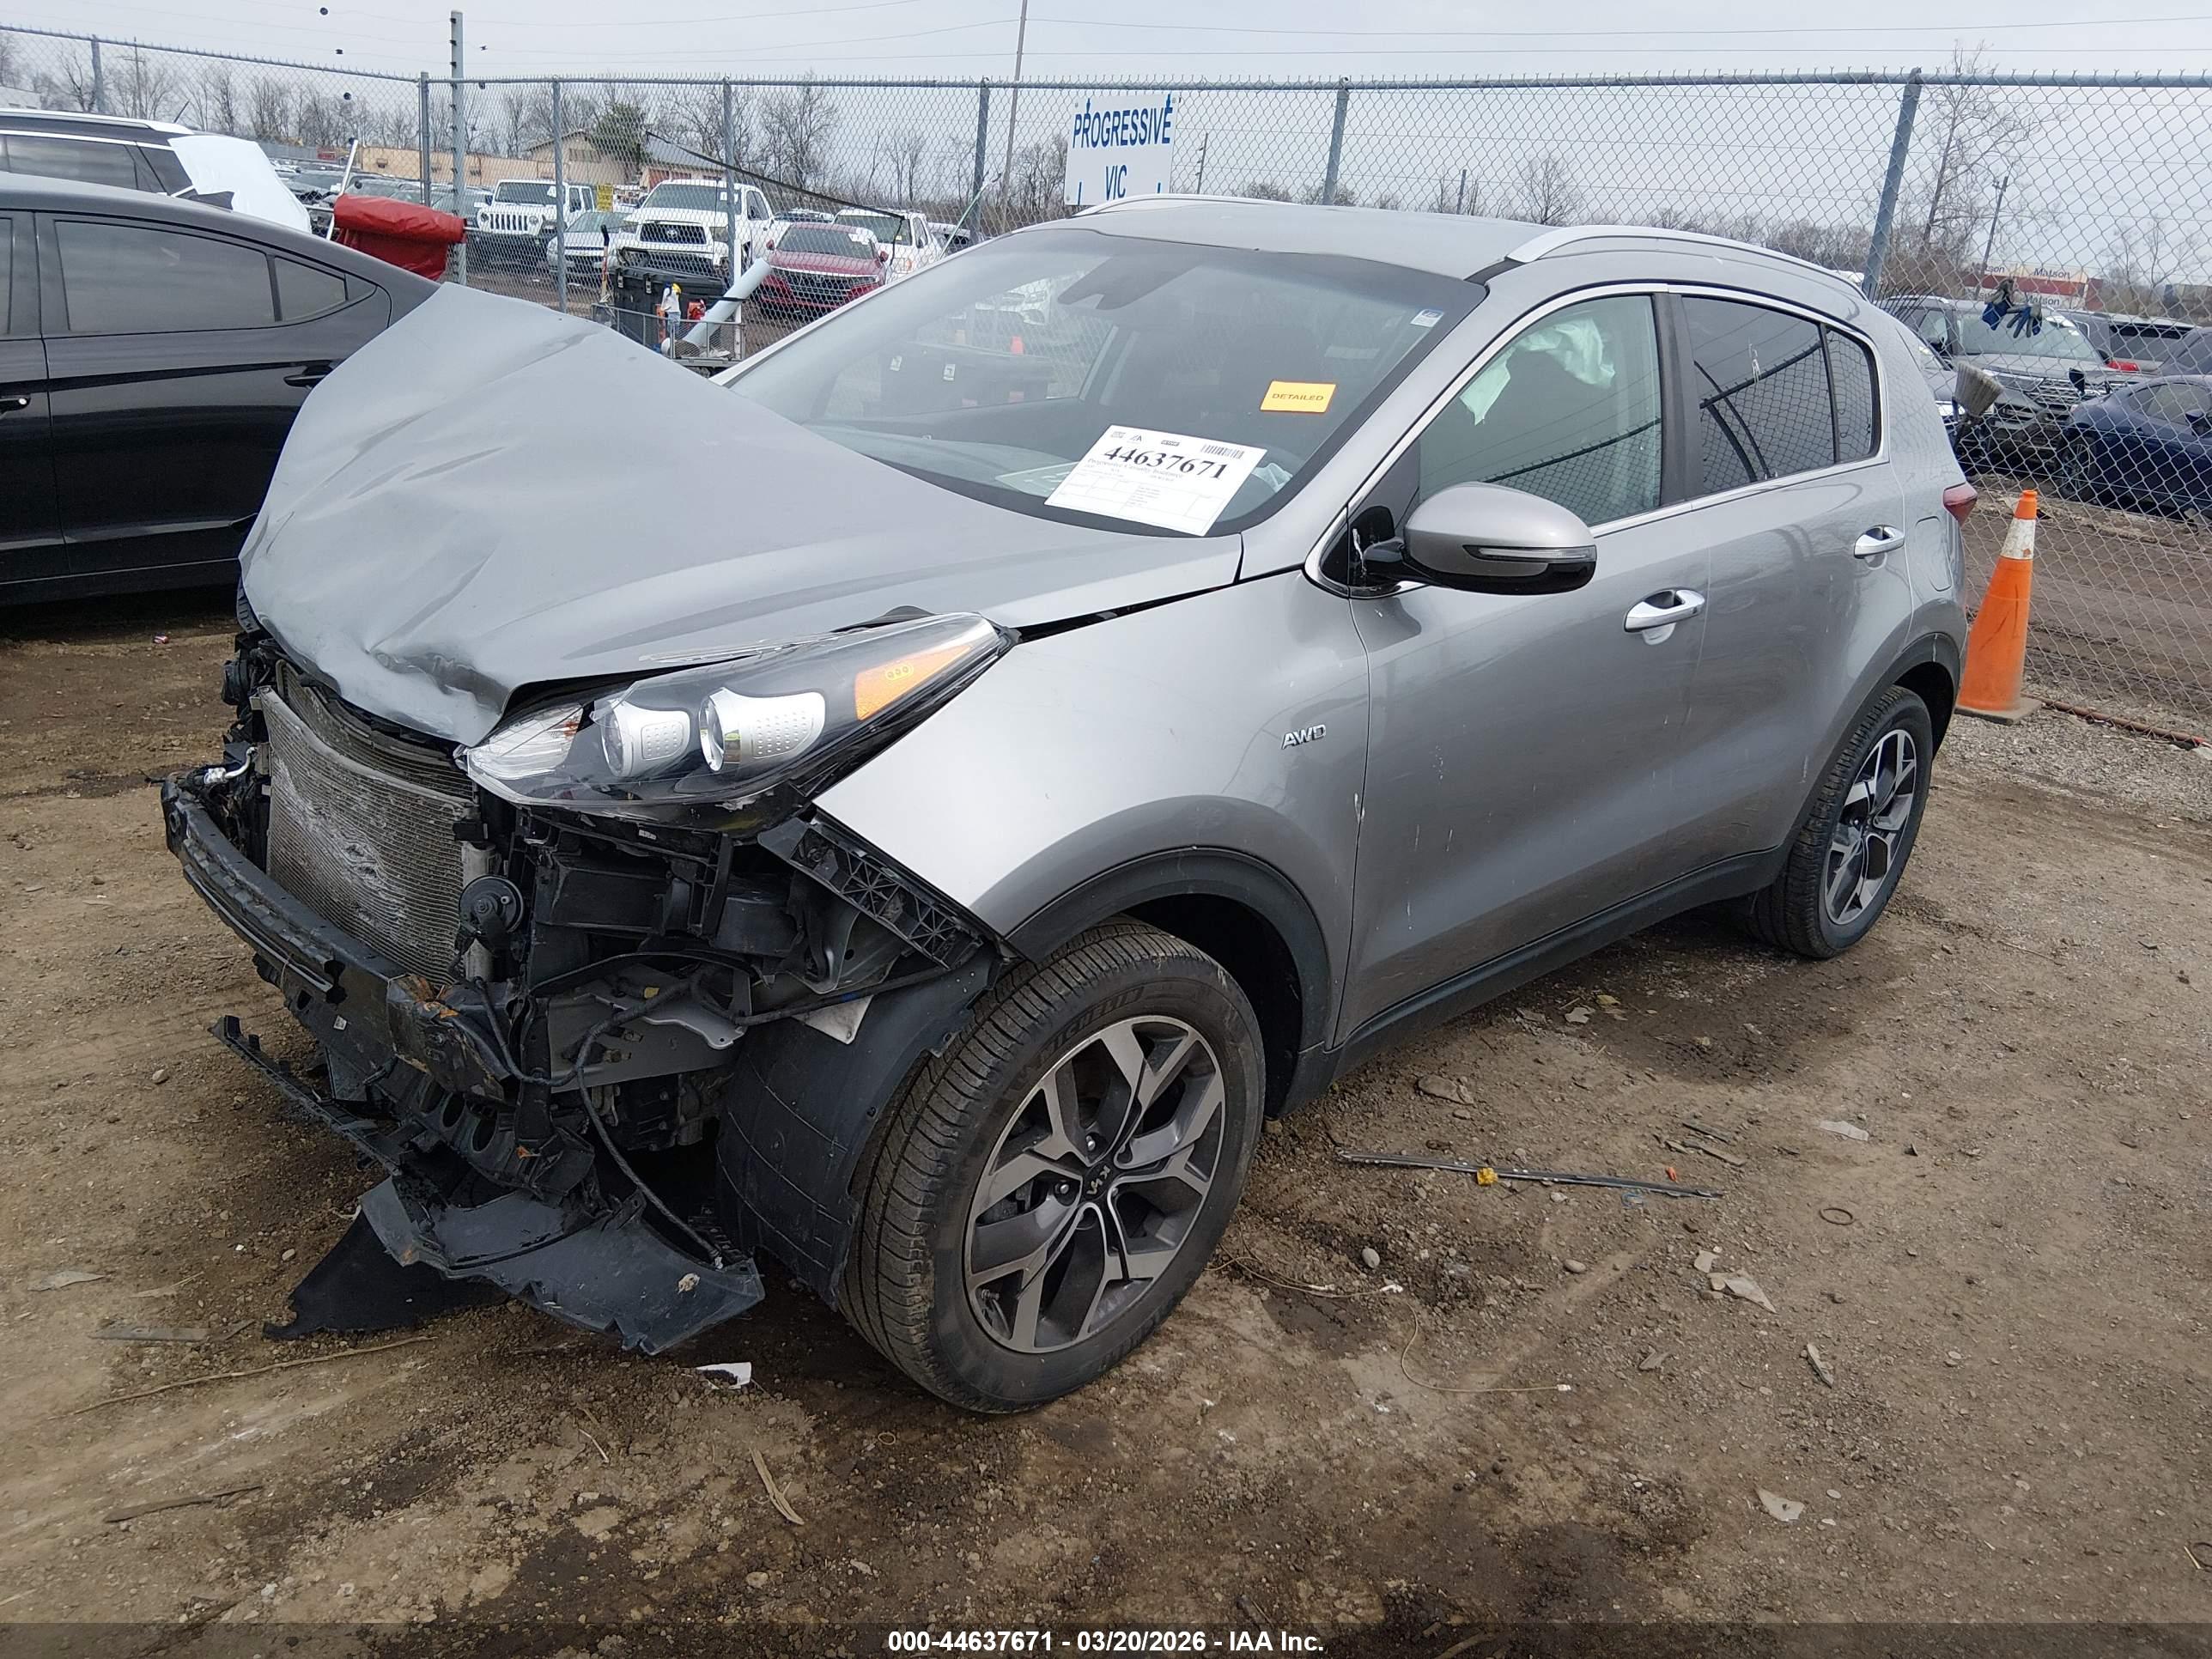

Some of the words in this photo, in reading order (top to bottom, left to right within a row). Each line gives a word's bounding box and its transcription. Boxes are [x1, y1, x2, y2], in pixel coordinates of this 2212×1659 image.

[1072, 107, 1173, 149] PROGRESSIVE
[1106, 164, 1127, 201] VIC
[2033, 267, 2070, 279] Matson
[1103, 446, 1228, 478] 44637671
[1281, 724, 1326, 749] AWD
